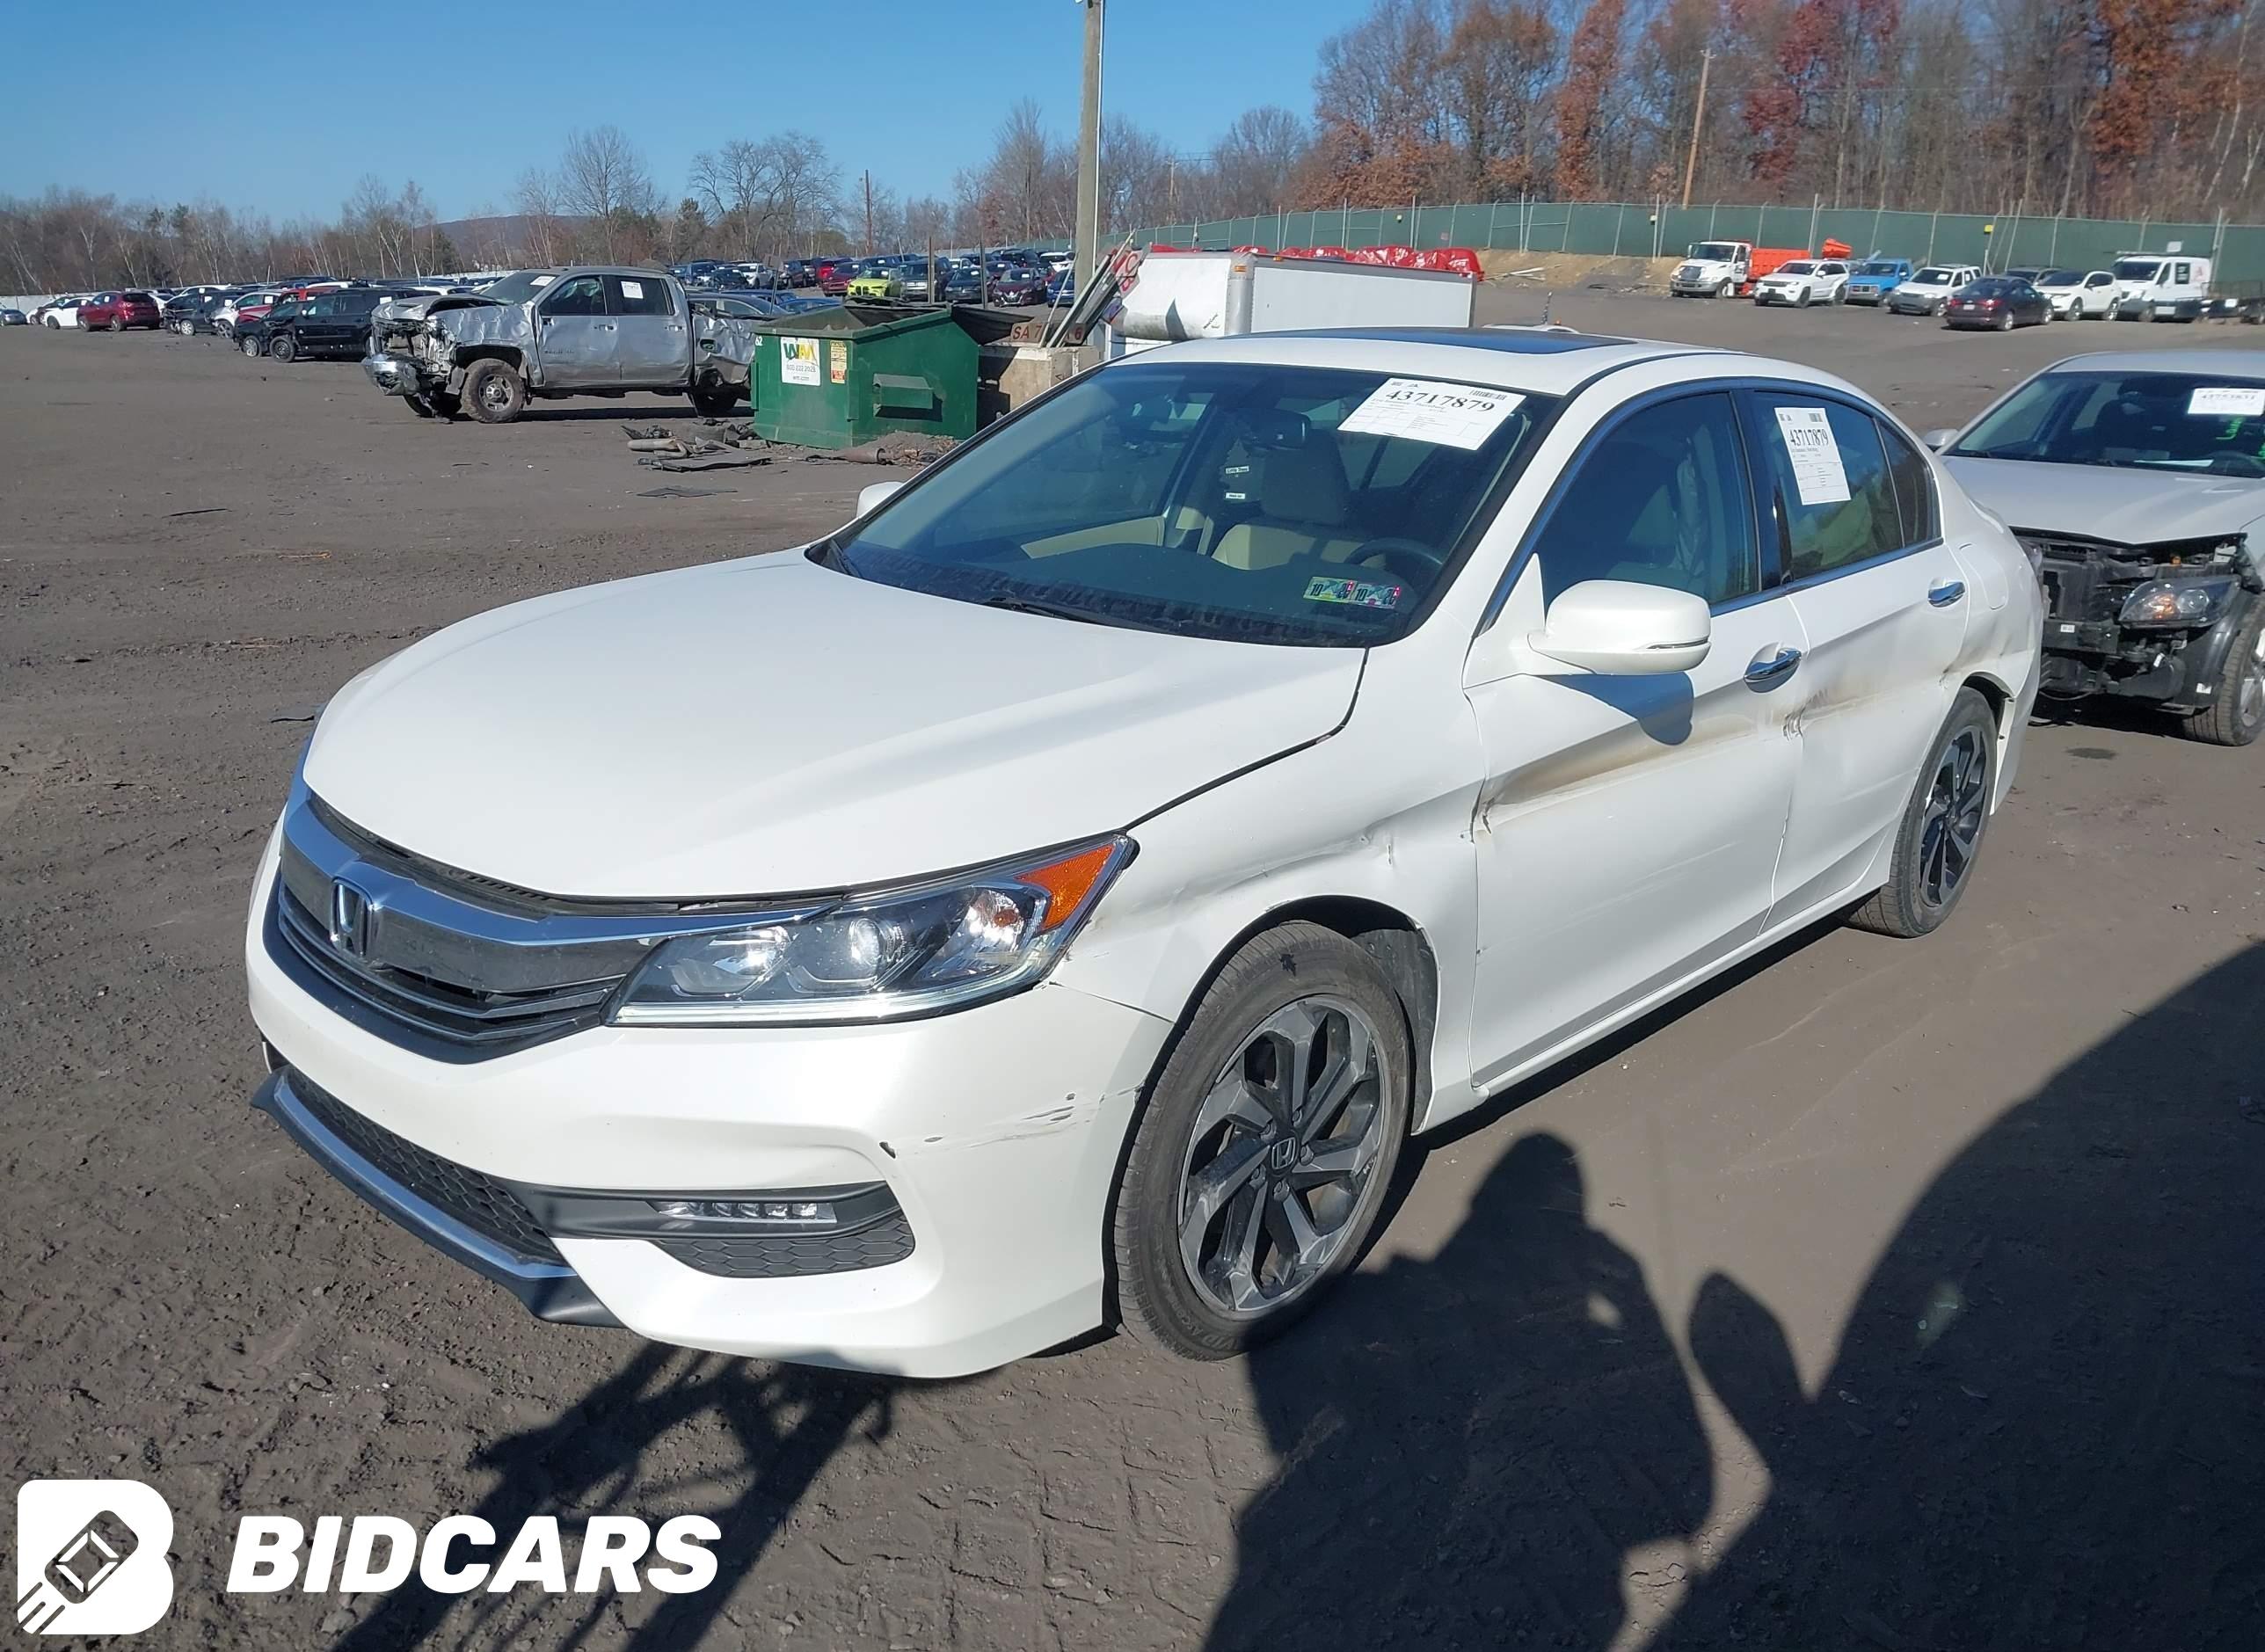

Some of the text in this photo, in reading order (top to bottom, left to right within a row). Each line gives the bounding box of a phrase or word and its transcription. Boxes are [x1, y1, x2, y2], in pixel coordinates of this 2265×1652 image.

[1013, 324, 1043, 340] SA 7
[1074, 326, 1083, 340] 6
[1385, 389, 1496, 412] 43717879
[1790, 429, 1829, 446] 43717879
[1310, 583, 1323, 597] 10
[1355, 588, 1367, 602] 10
